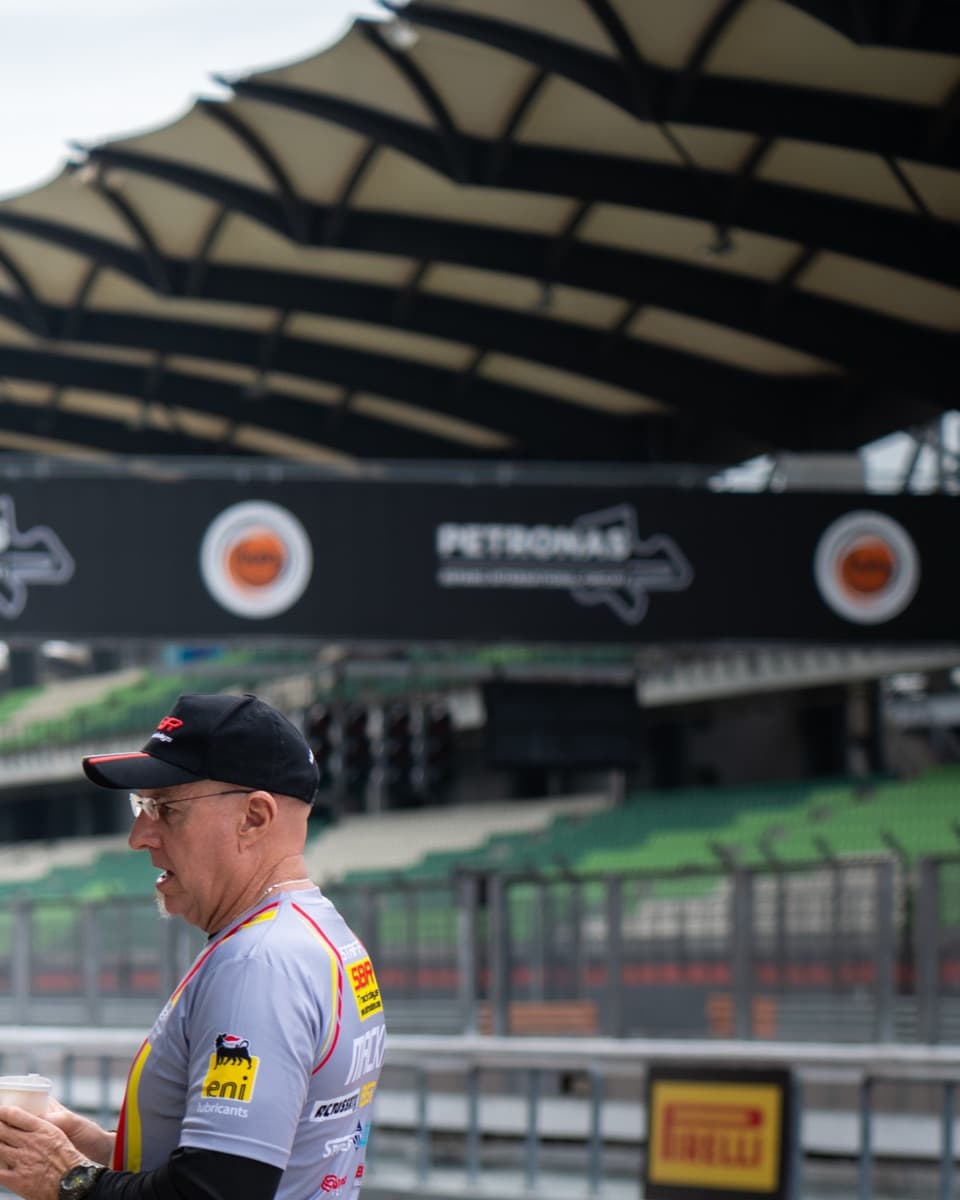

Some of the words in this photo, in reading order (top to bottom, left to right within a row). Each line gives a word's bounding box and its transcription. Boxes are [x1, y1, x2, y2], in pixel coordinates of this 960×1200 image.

[436, 522, 631, 562] PETRONAS
[206, 1075, 247, 1101] eni
[196, 1102, 249, 1118] lubricants
[661, 1101, 764, 1169] PIRELLI
